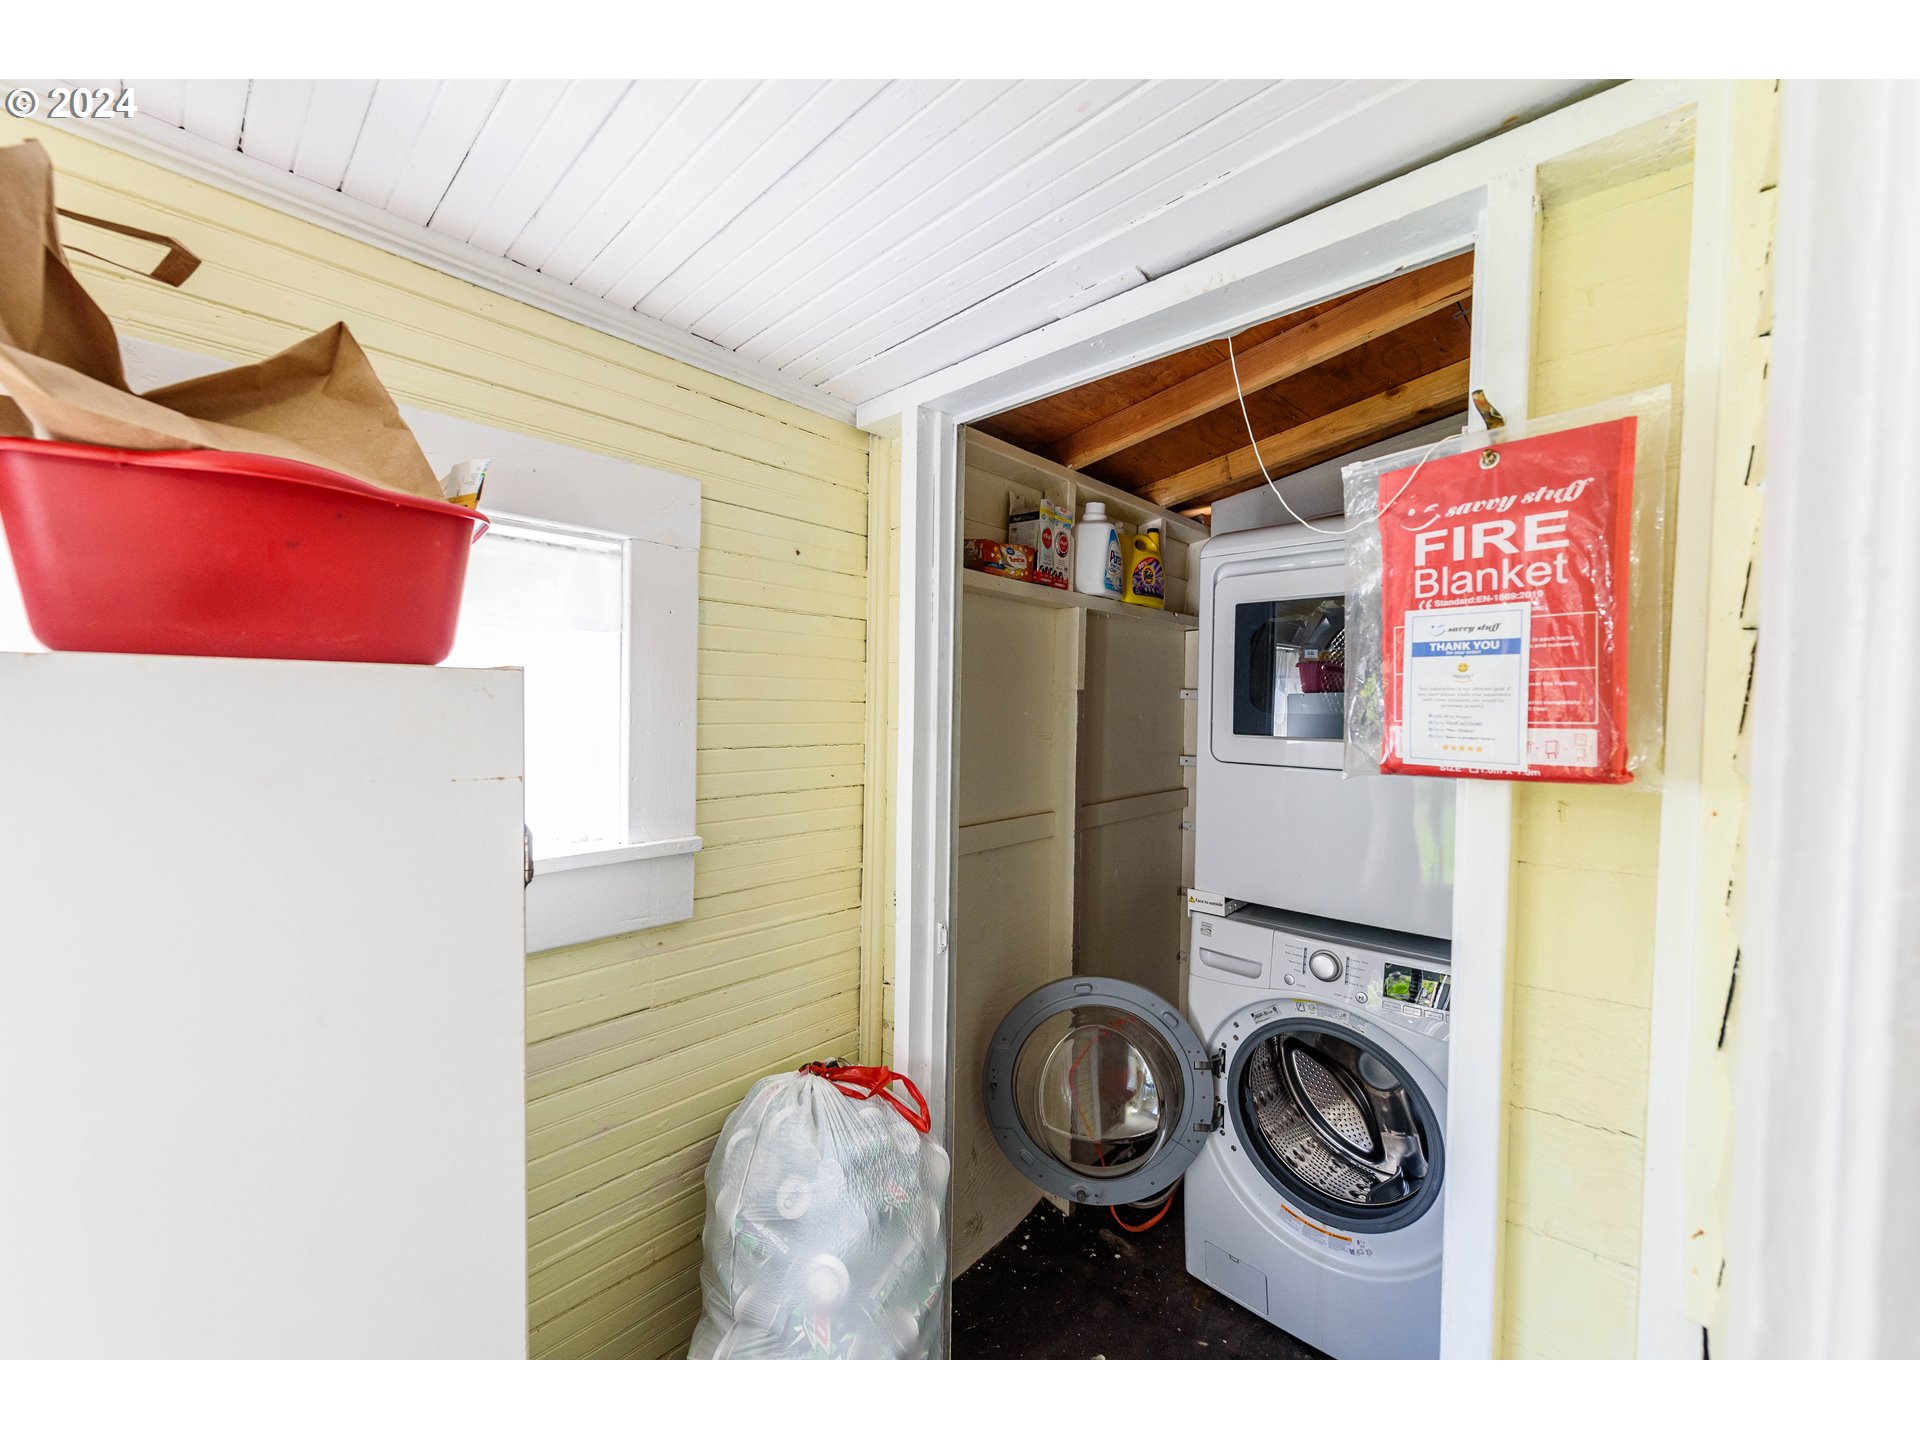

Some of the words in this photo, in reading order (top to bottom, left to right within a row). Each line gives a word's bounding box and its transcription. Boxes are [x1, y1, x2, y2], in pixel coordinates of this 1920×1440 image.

[1445, 495, 1518, 517] savvy
[1520, 477, 1595, 503] stuff
[1414, 510, 1570, 567] FIRE
[1414, 552, 1569, 599] Blanket
[1429, 641, 1471, 652] THANK
[1472, 640, 1500, 650] YOU
